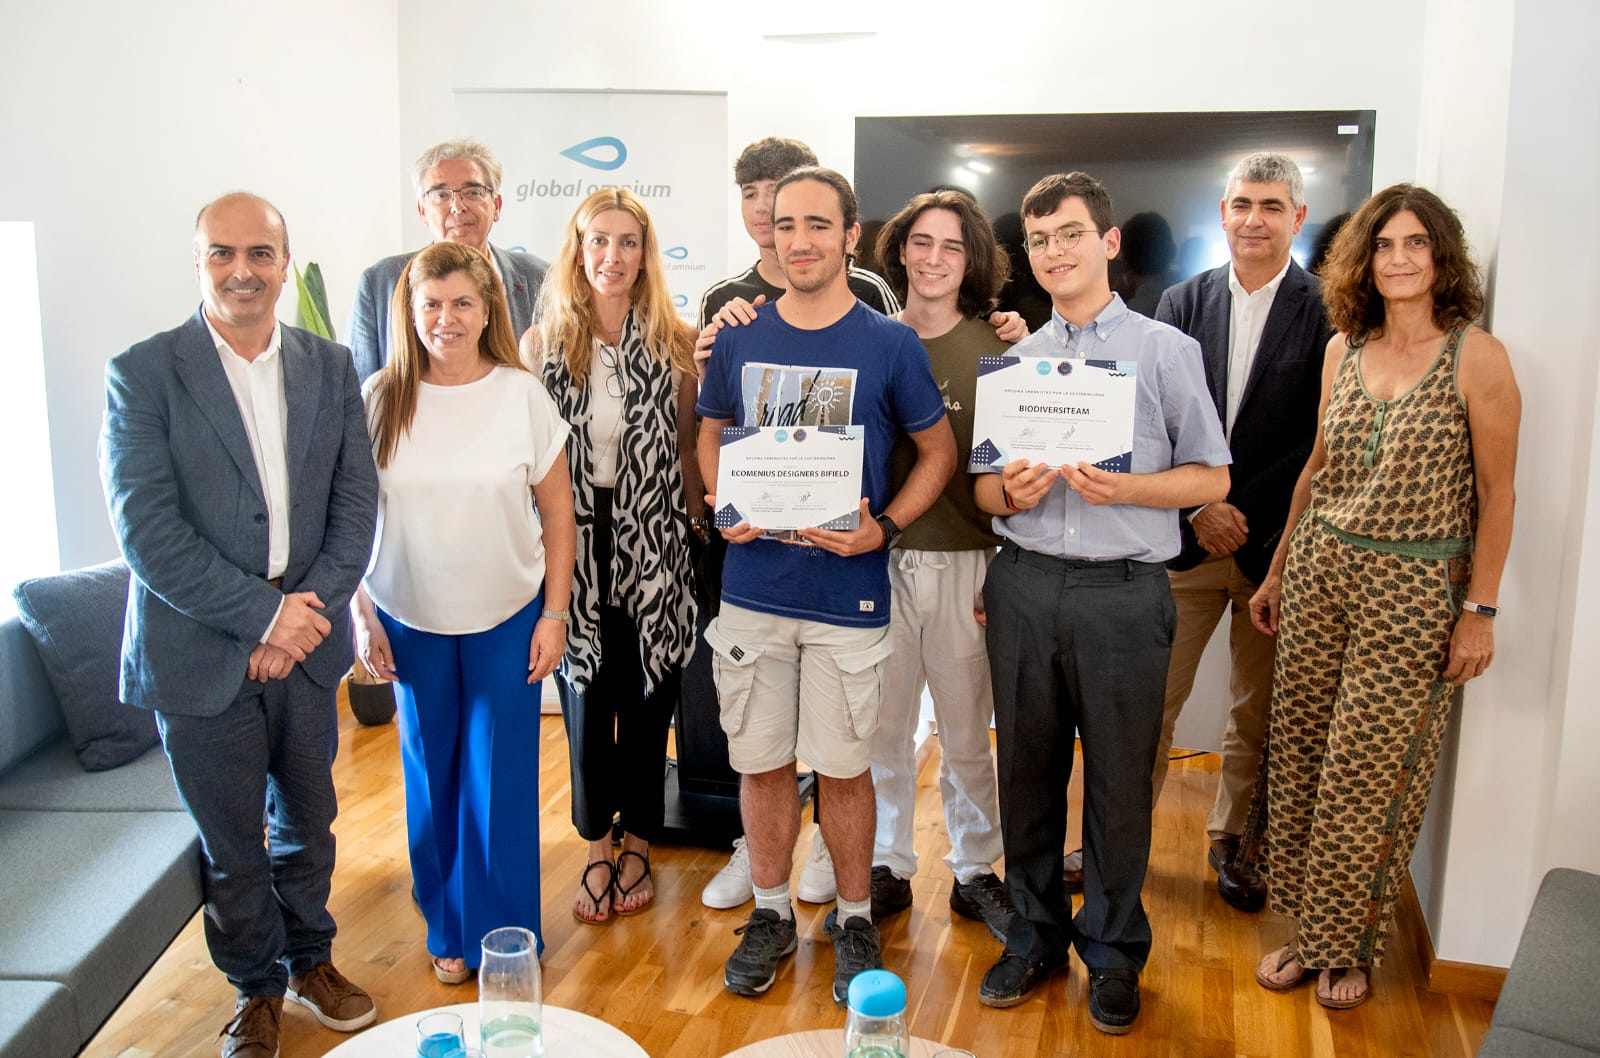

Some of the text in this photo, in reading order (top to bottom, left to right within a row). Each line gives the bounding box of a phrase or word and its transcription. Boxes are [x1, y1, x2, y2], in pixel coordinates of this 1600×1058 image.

[516, 179, 582, 202] global
[1019, 404, 1090, 415] BIODIVERSITEAM
[777, 470, 819, 478] DESIGNERS
[820, 470, 850, 478] BIFIELD
